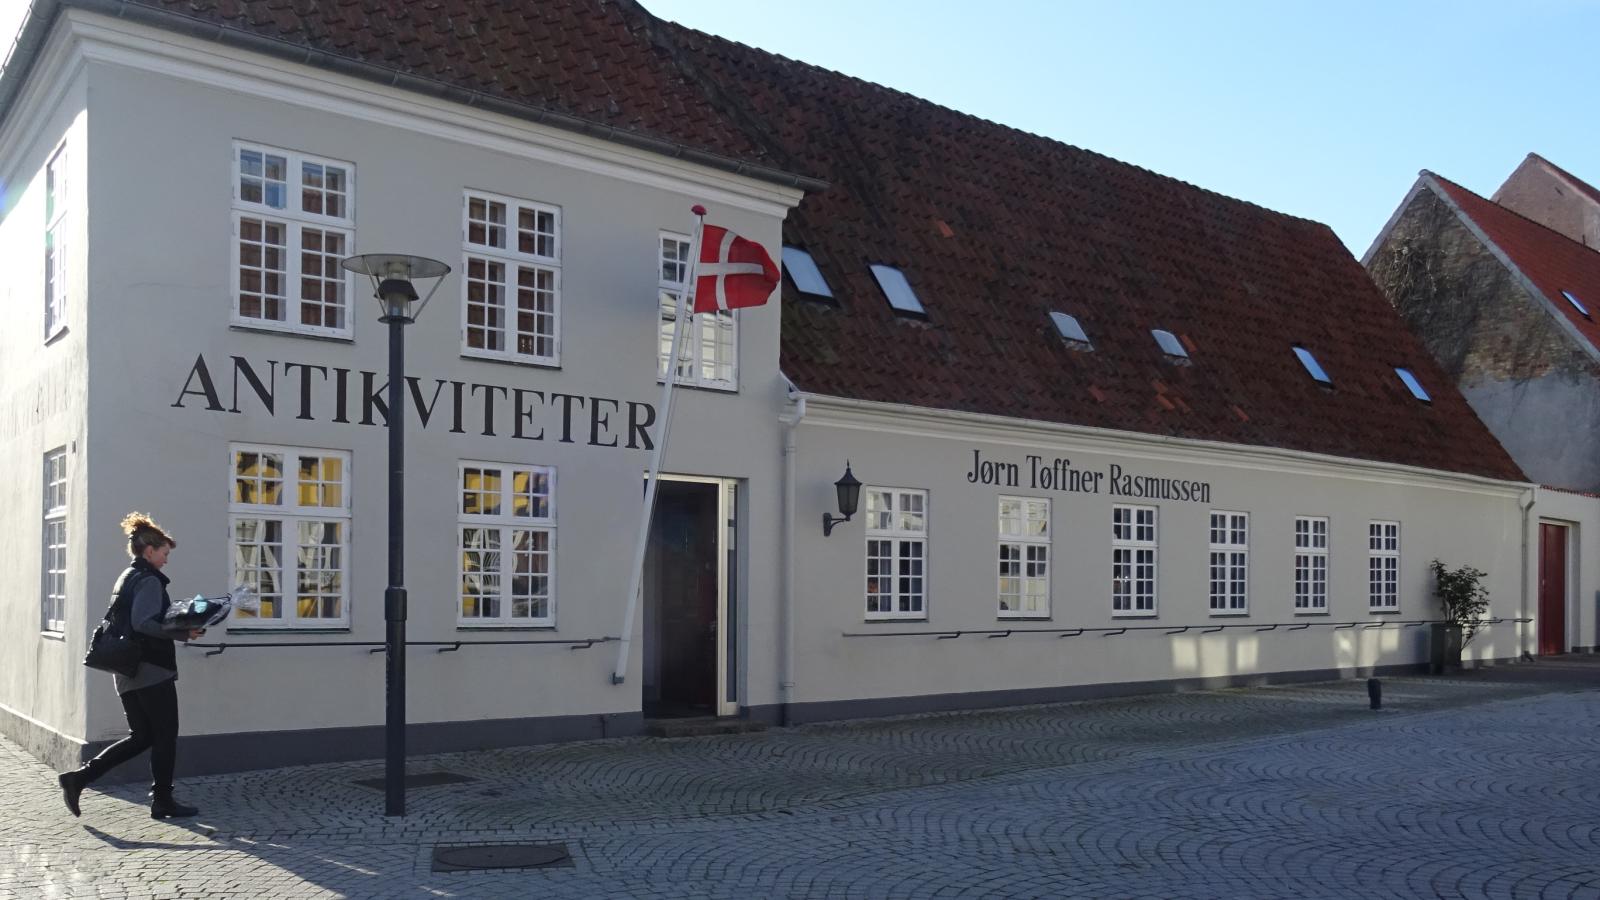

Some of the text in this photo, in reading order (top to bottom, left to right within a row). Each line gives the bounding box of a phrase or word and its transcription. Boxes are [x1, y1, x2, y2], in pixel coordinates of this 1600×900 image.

[171, 353, 657, 450] ANTIKVITETER
[967, 449, 1210, 503] Jørn Tøffner Rasmussen
